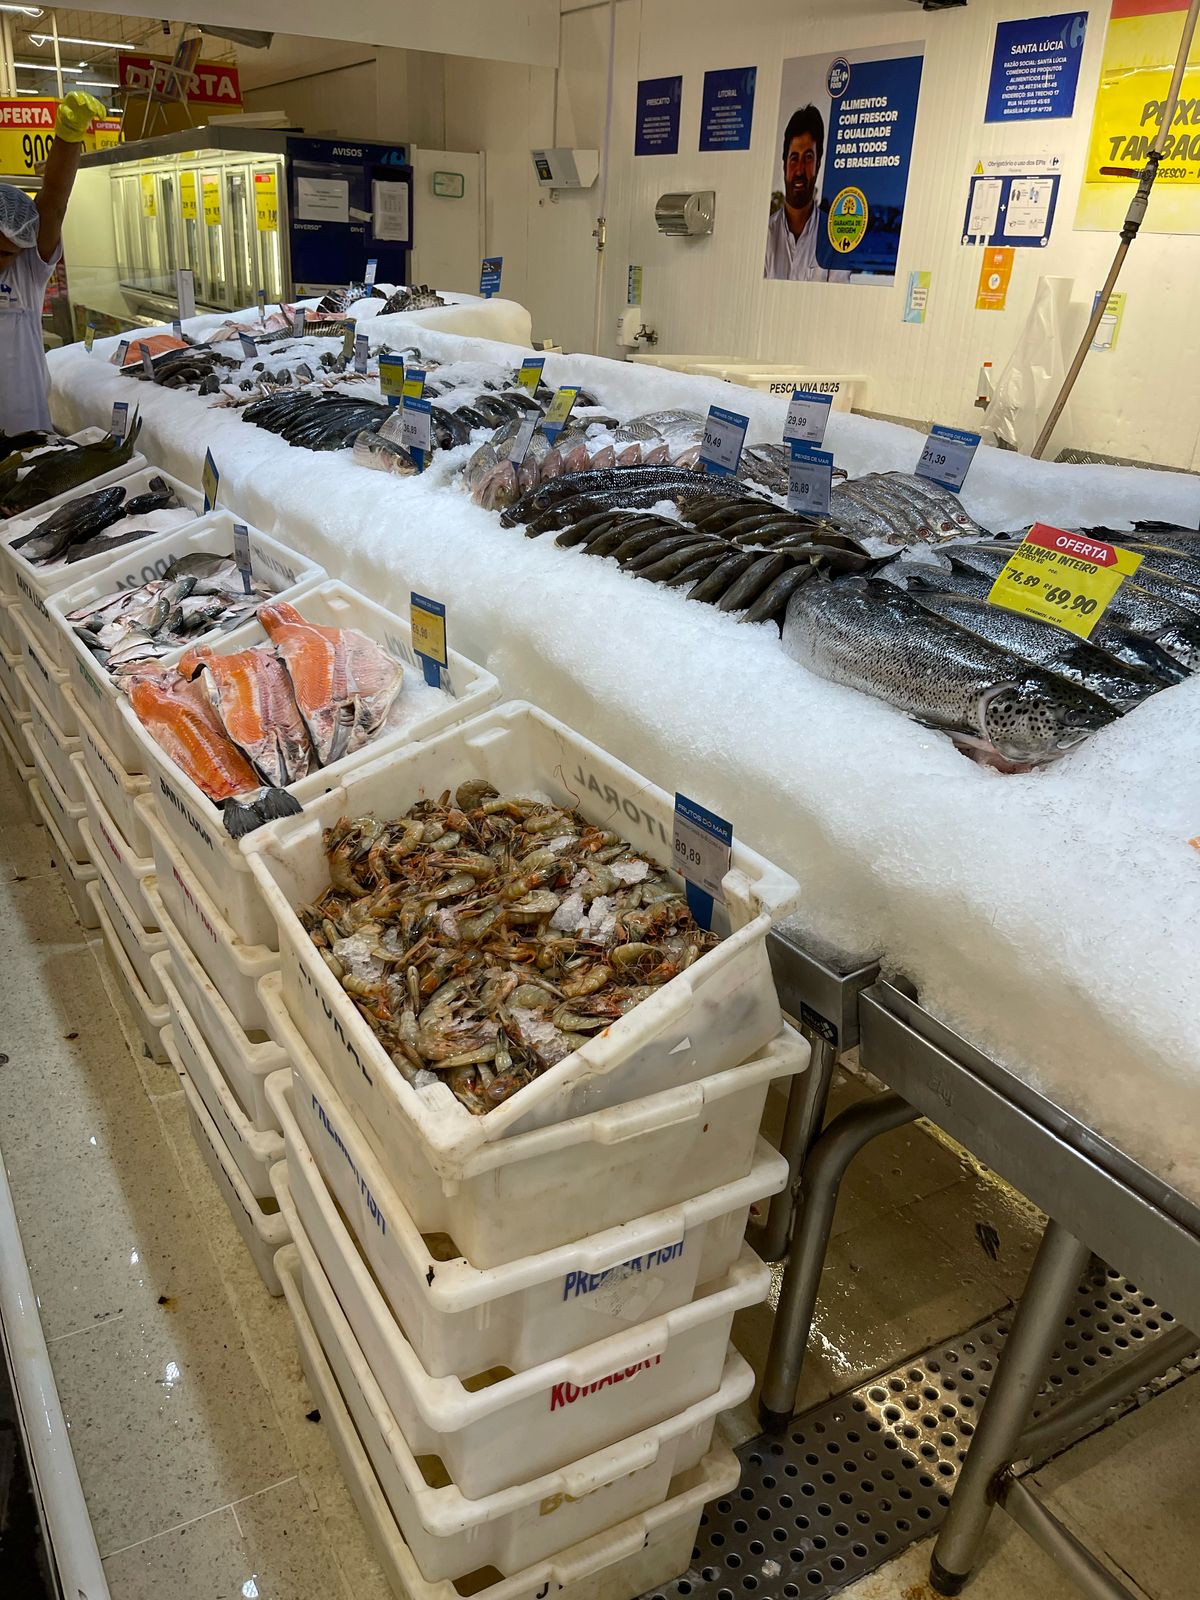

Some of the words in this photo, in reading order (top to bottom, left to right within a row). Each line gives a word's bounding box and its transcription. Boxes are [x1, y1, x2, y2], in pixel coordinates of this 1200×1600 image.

[1011, 43, 1037, 55] SANTA
[1038, 39, 1064, 52] LÚCIA
[1004, 60, 1019, 68] RAZÃO
[1006, 67, 1029, 75] COMÉRCIO
[1037, 65, 1062, 73] PRODUTOS
[126, 65, 237, 99] OFRTA
[717, 89, 738, 98] LITORAL
[840, 96, 887, 111] ALIMENTOS
[839, 114, 858, 125] COM
[859, 110, 898, 124] FRESCOR
[1140, 98, 1200, 127] PEXE
[96, 122, 120, 130] OFERTA
[837, 130, 843, 140] E
[844, 126, 891, 140] QUALIDADE
[332, 147, 363, 158] AVISOS
[836, 143, 857, 154] PARA
[858, 141, 887, 153] TODOS
[834, 158, 846, 169] OS
[846, 155, 900, 168] BRASILEIROS
[770, 383, 797, 394] PESCA
[800, 382, 818, 393] VIVA
[819, 382, 840, 393] 03/25
[787, 415, 807, 427] 29,99
[704, 432, 722, 448] 70,49
[922, 450, 946, 465] 21,39
[790, 481, 810, 494] 26,89
[1016, 549, 1036, 563] FRESCO
[1056, 536, 1108, 561] OFERTA
[1057, 556, 1098, 575] INTEIRO
[1007, 568, 1041, 588] 76,89
[1043, 582, 1053, 591] R$
[1045, 586, 1098, 616] 69,90
[677, 802, 702, 822] FRUTOS
[701, 816, 713, 828] DO
[712, 823, 728, 837] MAR
[675, 838, 702, 866] 89,89
[563, 1256, 642, 1301] PRER
